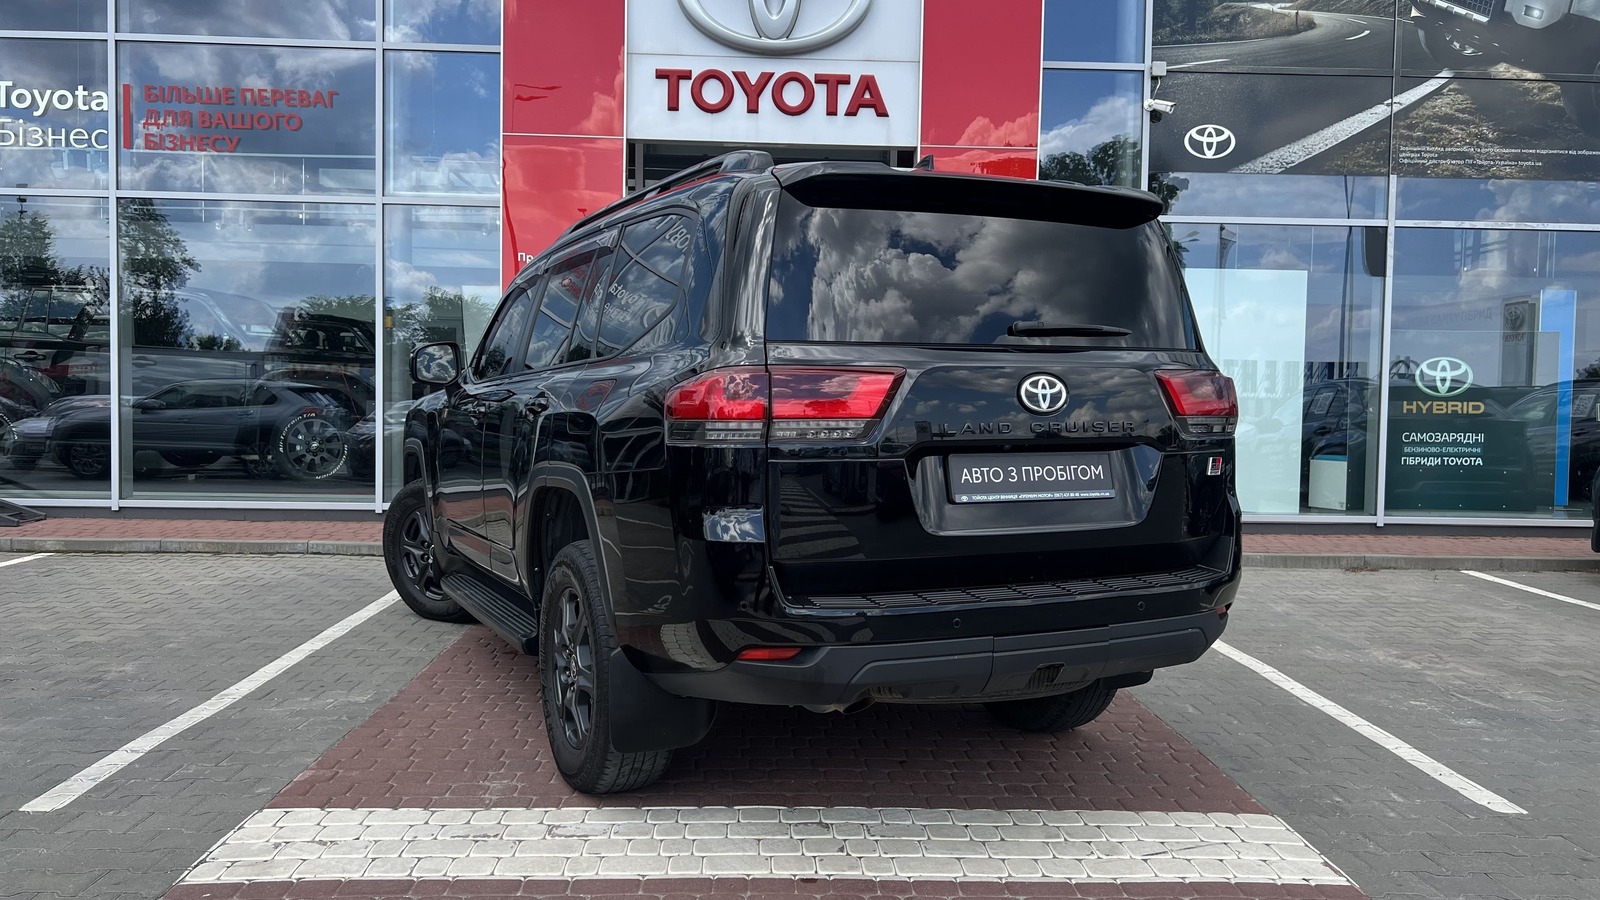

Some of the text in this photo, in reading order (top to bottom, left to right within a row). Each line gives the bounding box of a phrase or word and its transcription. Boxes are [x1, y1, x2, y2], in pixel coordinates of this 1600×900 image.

[0, 81, 108, 116] Toyota
[144, 85, 337, 108] БІЛЬШЕ ПЕРЕВАГ
[655, 68, 890, 117] TOYOTA
[143, 109, 302, 131] ДЛЯ ВАШОГО
[0, 118, 108, 149] Бізнес
[144, 133, 241, 152] БІЗНЕСУ
[1402, 400, 1485, 415] HYBRID
[943, 421, 1136, 436] LAND CRUISER
[1402, 432, 1485, 445] САМОЗАРЯДНІ
[1403, 446, 1482, 454] БЕНЗИНОВО-ЕЛЕКТРИЧНІ
[1401, 456, 1483, 467] ГІБРИДИ TOYOTA
[961, 464, 1104, 484] АВТО З ПРОБІГОМ
